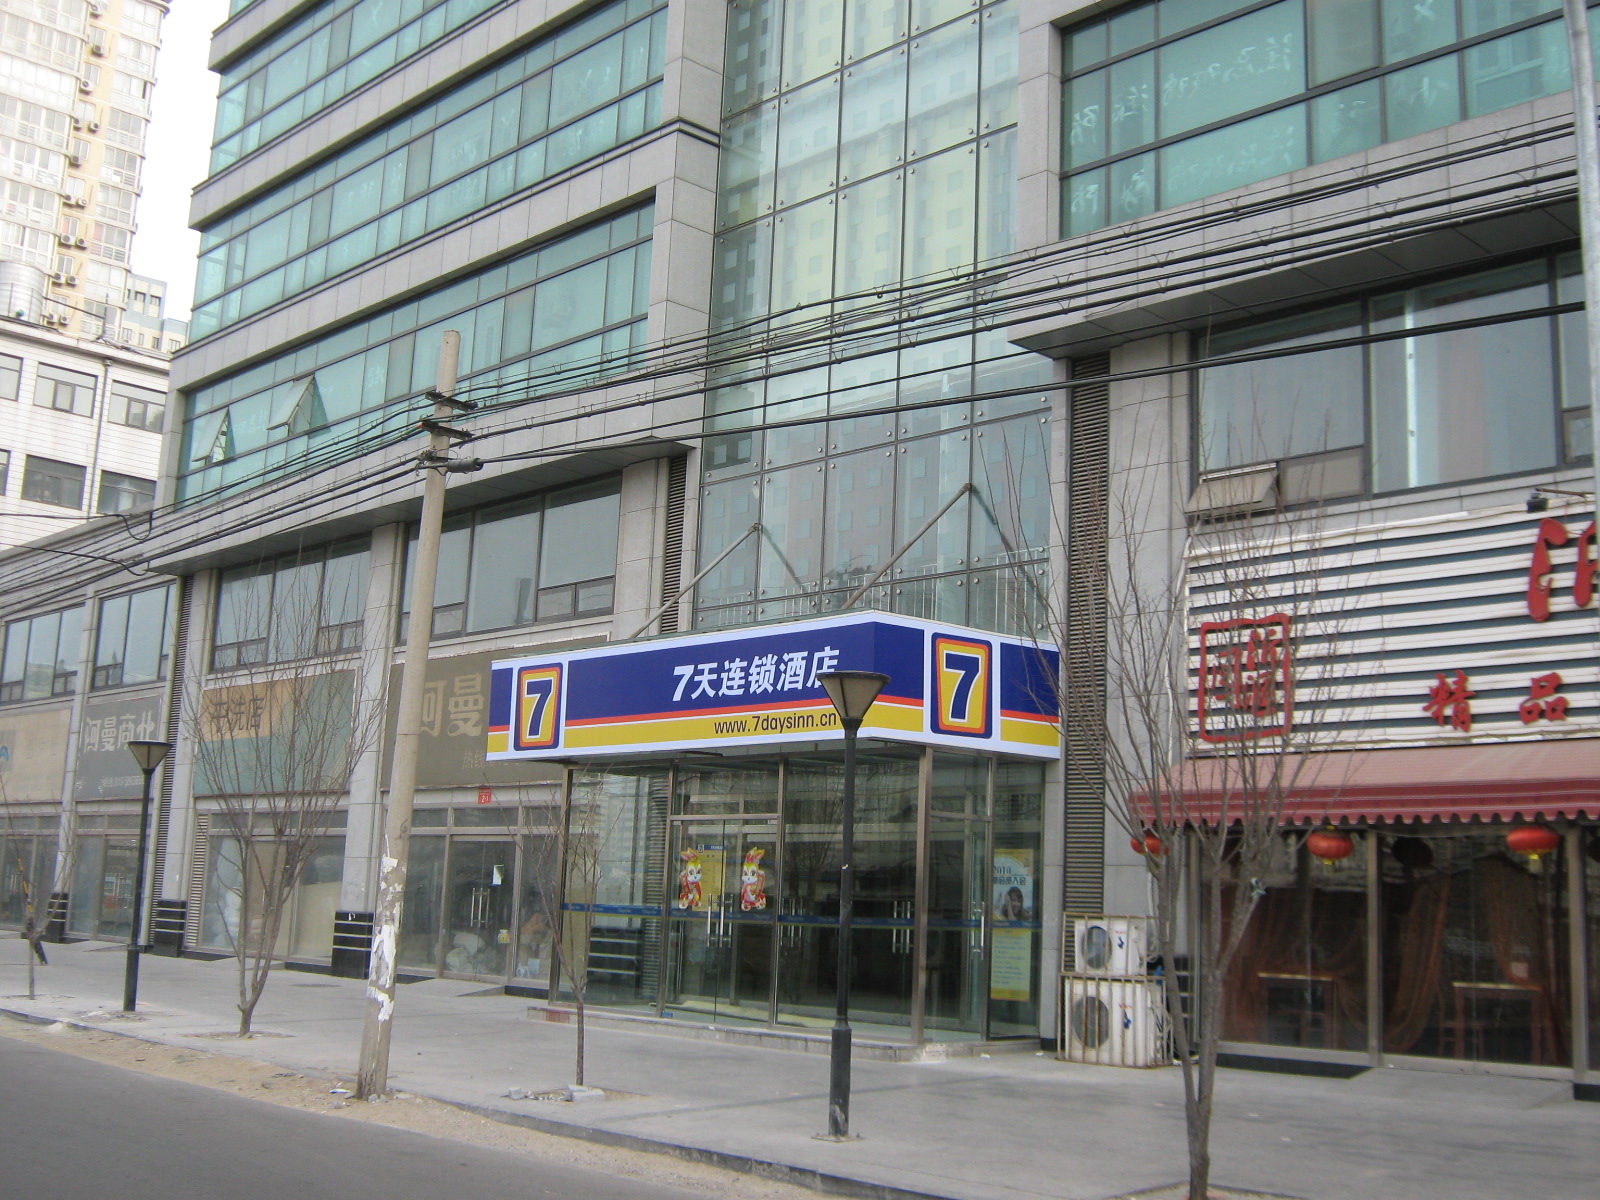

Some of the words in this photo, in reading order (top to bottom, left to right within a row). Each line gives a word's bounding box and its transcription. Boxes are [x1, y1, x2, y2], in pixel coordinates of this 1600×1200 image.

[672, 645, 840, 702] 7天连锁酒店
[943, 649, 982, 723] 7
[1422, 669, 1570, 733] 精品
[524, 677, 554, 739] 7
[714, 712, 837, 734] www.7daysinn.cn
